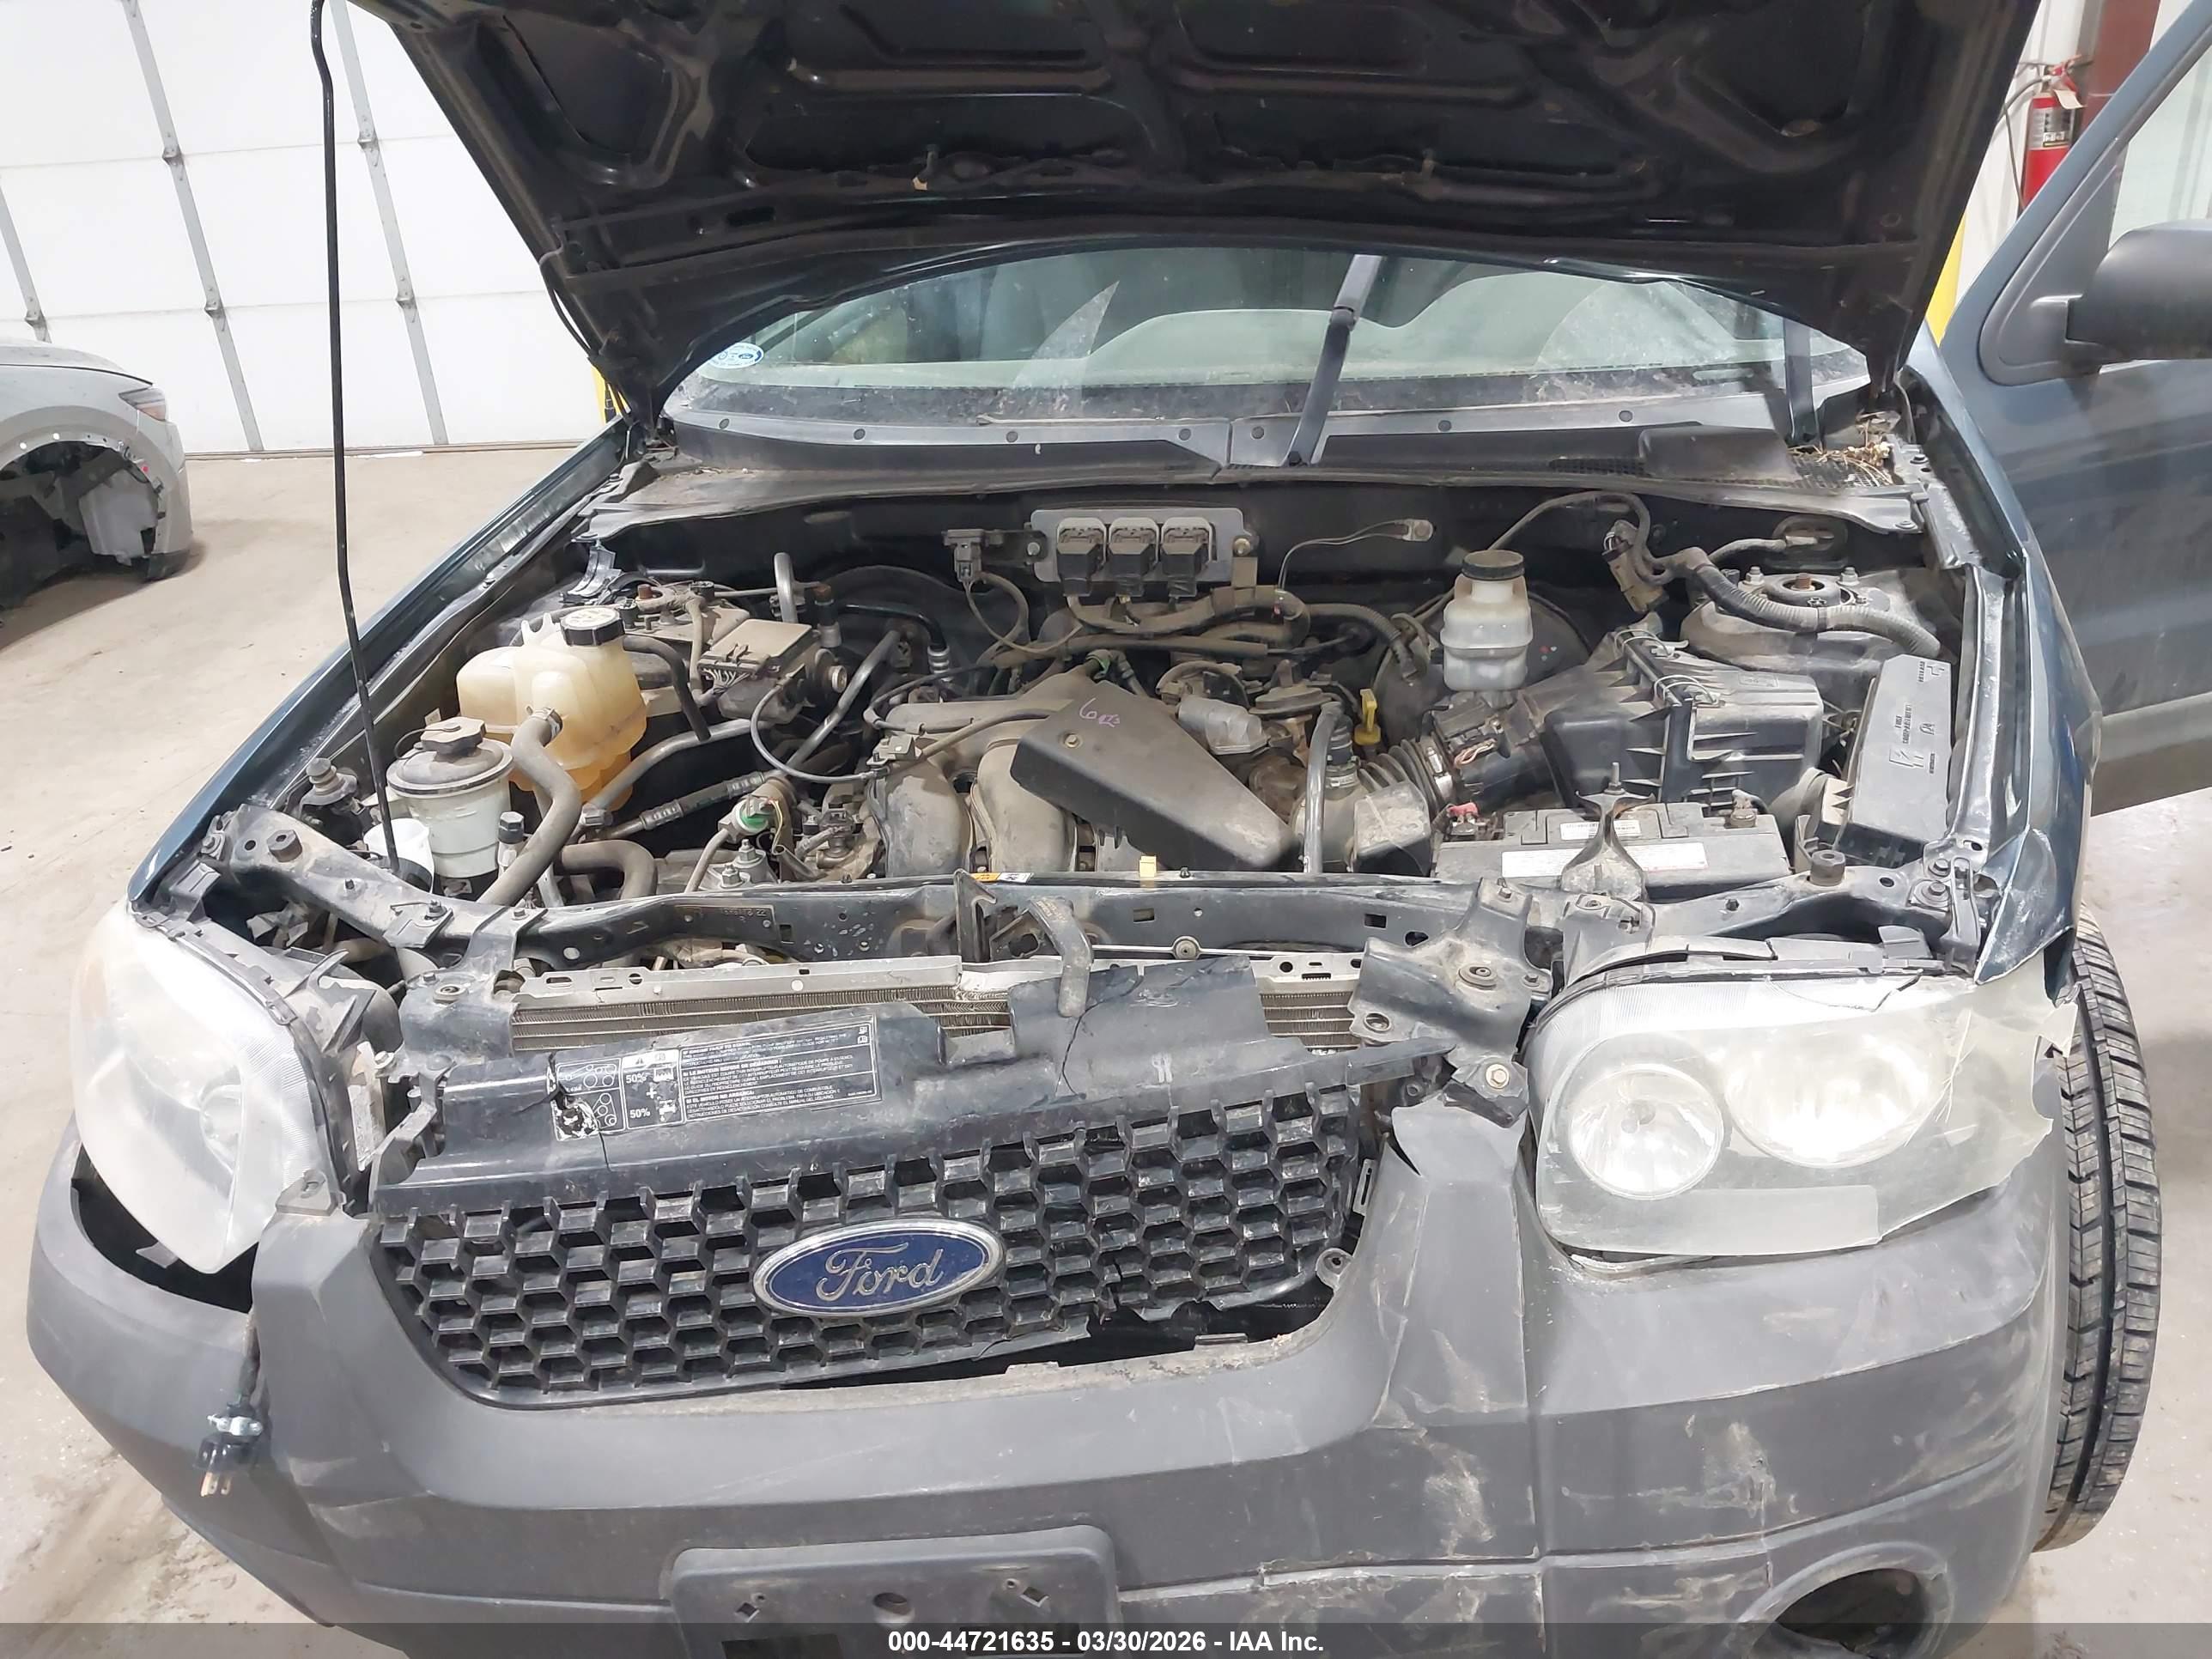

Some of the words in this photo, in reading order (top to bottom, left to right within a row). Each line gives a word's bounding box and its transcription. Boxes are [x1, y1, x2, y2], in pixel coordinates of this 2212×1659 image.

[625, 1073, 647, 1084] 50%
[629, 1108, 651, 1119] 50%
[815, 1242, 944, 1302] Ford
